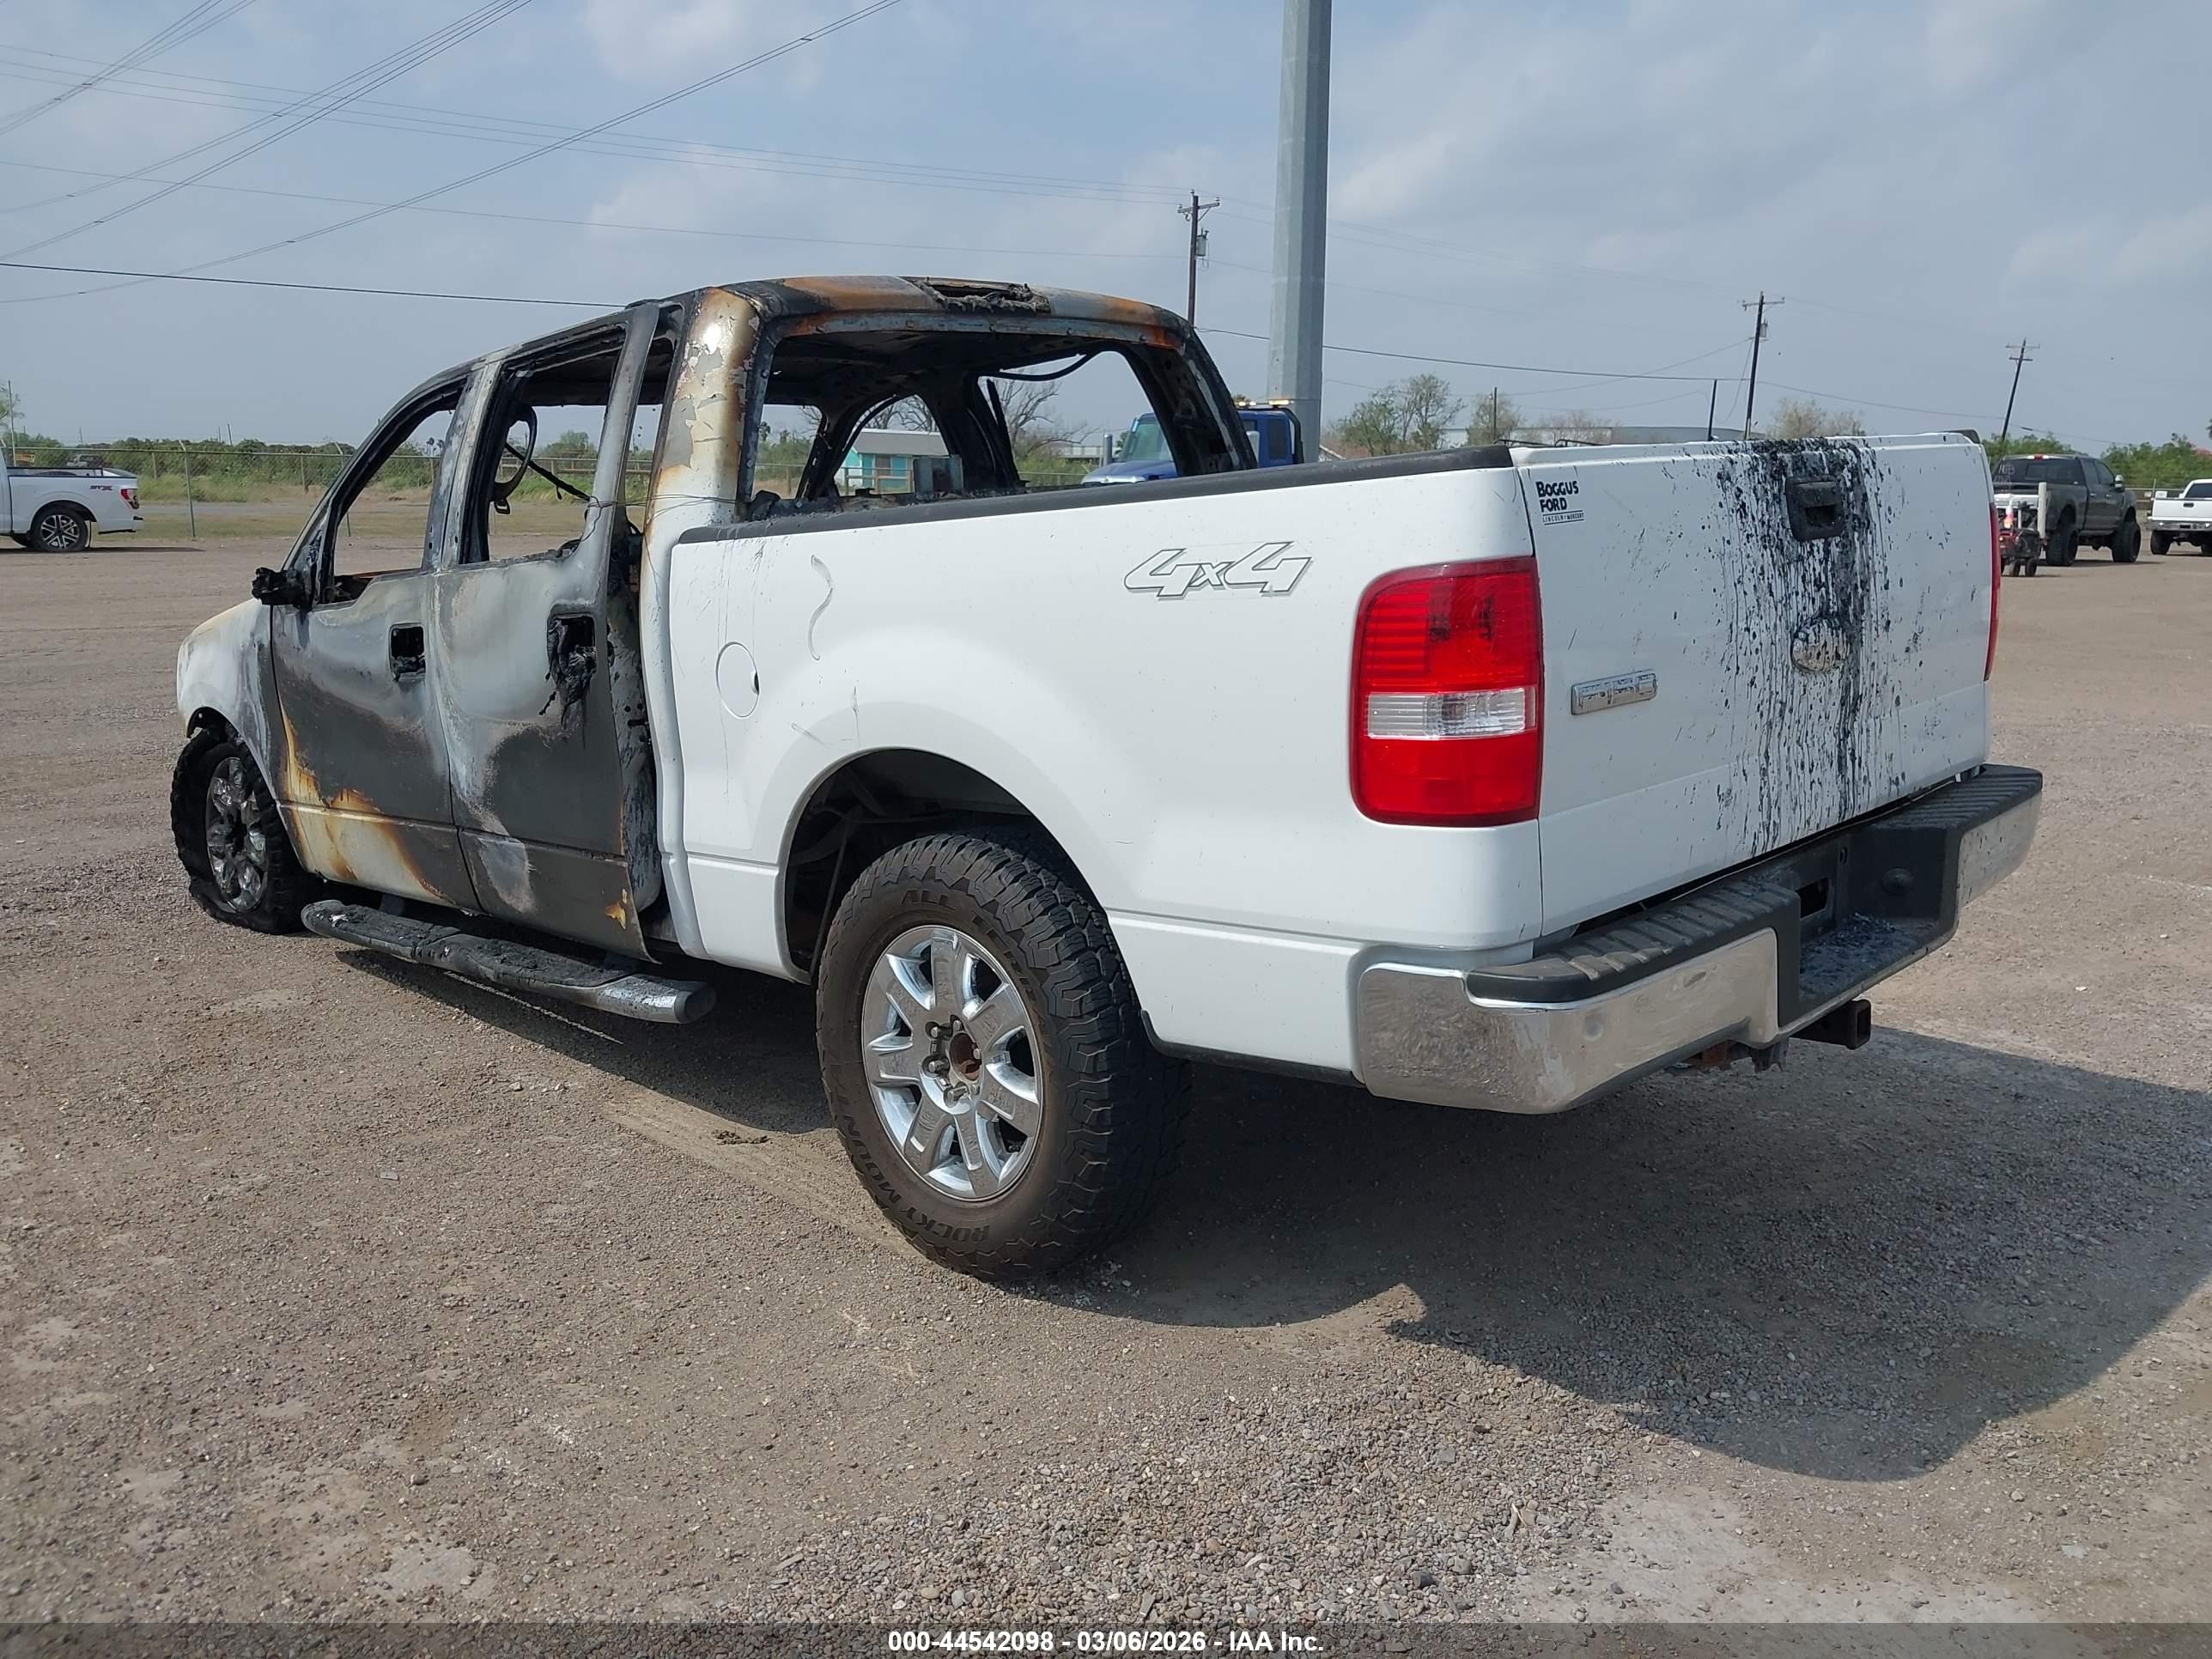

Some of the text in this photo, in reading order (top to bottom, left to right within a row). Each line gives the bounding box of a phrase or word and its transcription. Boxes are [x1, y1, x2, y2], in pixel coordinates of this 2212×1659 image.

[1535, 480, 1579, 498] BOGGUS
[1539, 497, 1568, 513] FORD
[902, 889, 956, 911] ALL
[900, 1206, 990, 1243] ROCKY
